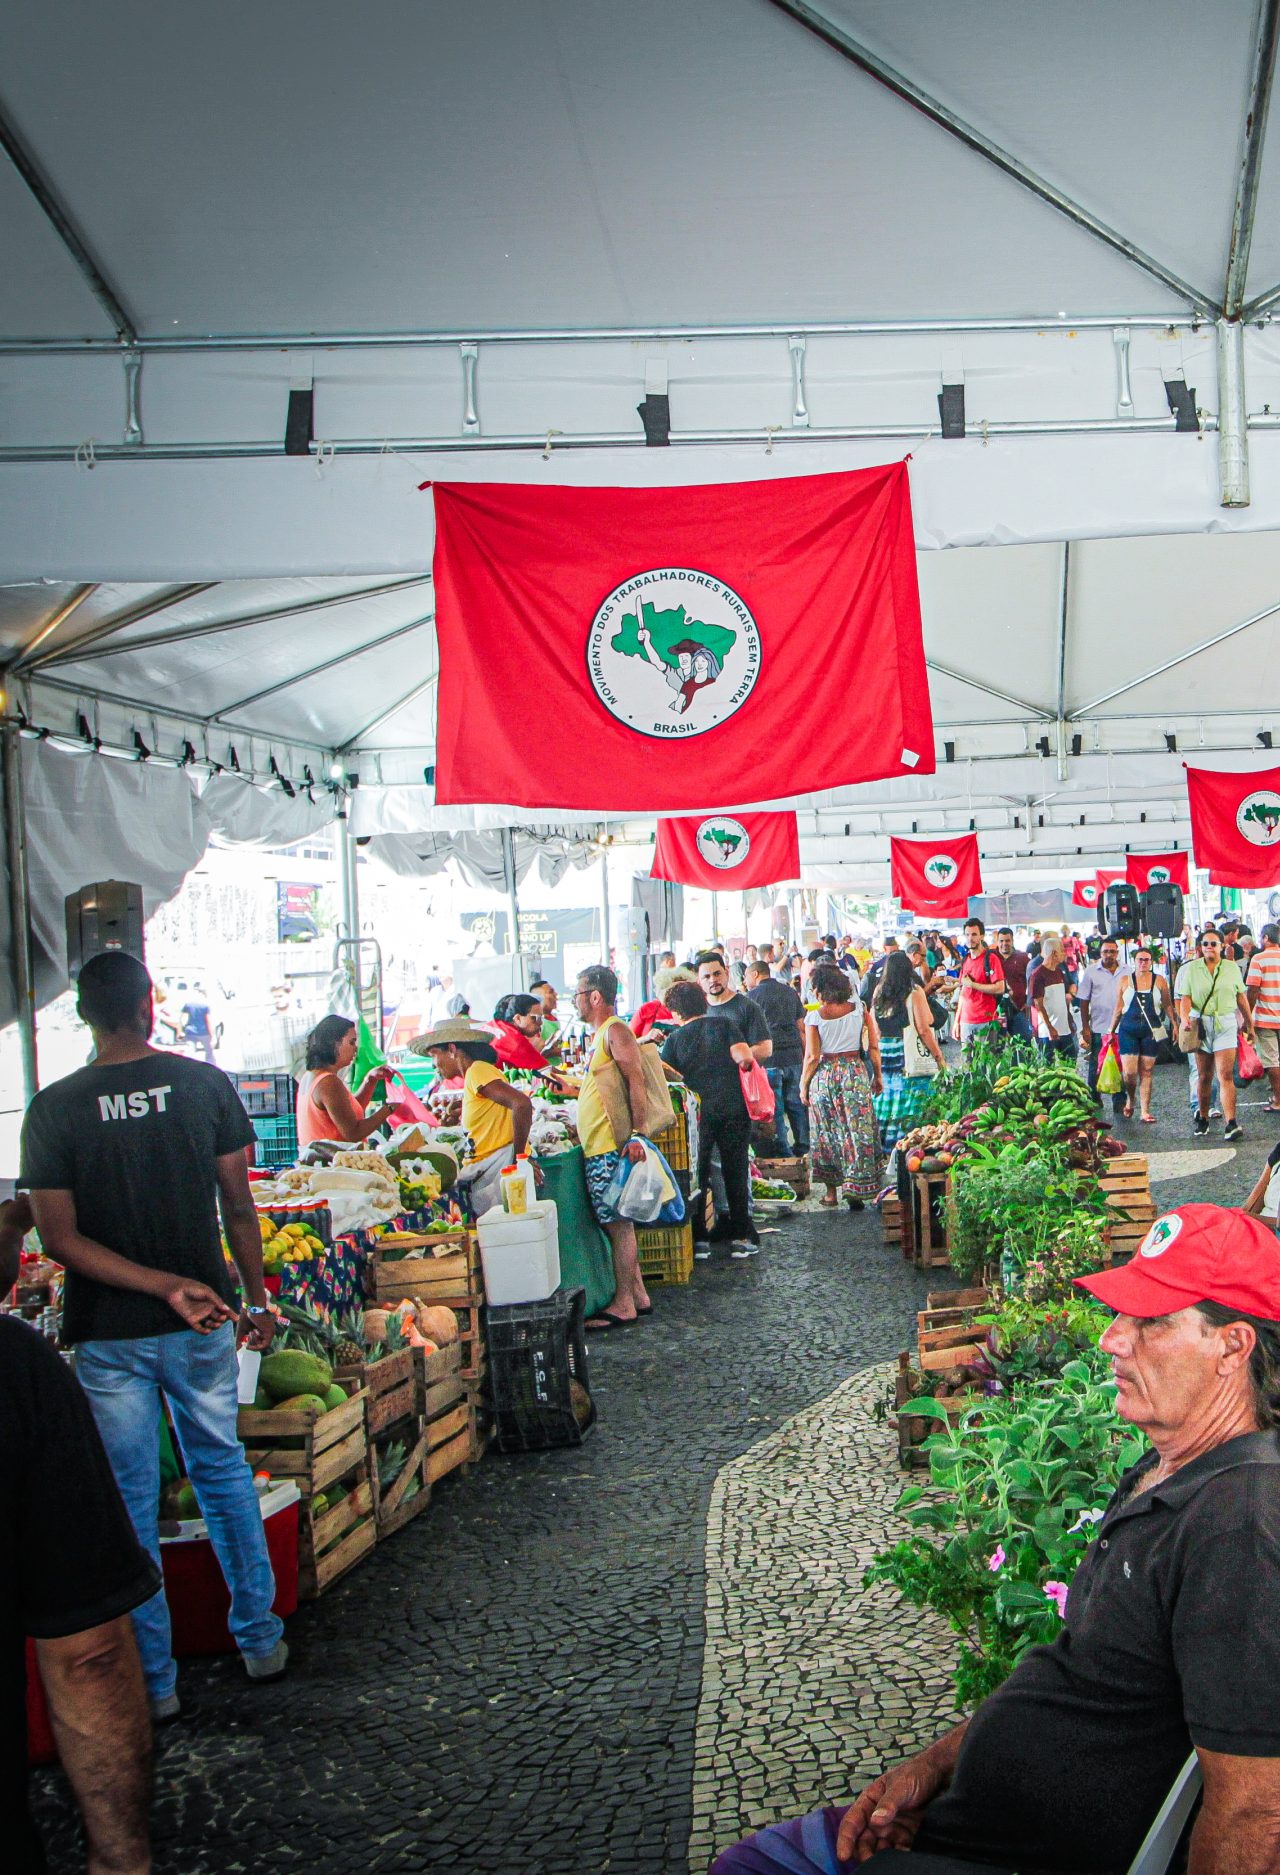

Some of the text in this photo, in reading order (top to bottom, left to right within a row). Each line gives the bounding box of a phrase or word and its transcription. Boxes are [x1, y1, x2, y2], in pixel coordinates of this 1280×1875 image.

[591, 571, 757, 705] MOVIMENTO DOS TRABALHADORES RURAIS SEM TERRA
[653, 722, 698, 733] BRASIL
[520, 933, 552, 941] AND UP
[98, 1085, 172, 1121] MST
